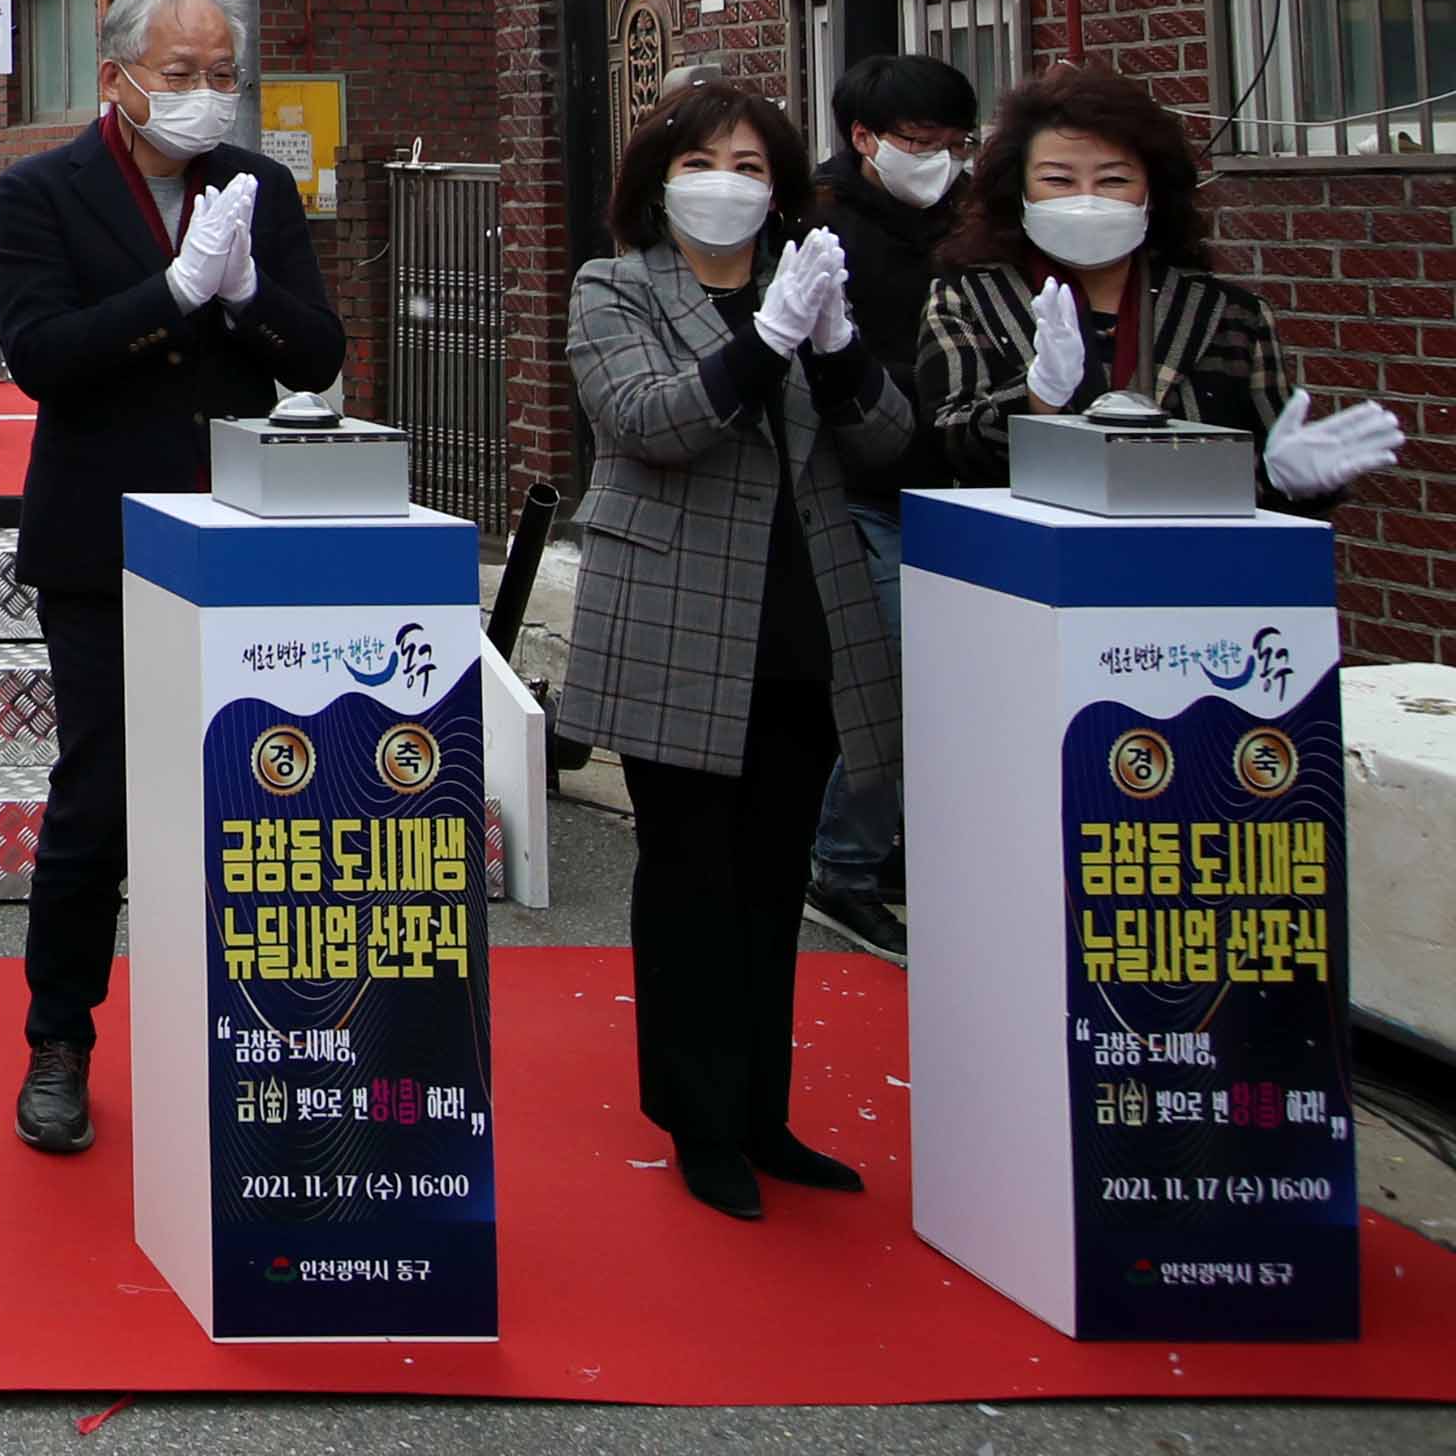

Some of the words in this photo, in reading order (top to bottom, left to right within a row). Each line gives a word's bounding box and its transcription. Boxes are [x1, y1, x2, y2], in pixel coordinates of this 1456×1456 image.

[270, 745, 294, 777] 경
[394, 741, 422, 774] 축
[1128, 748, 1153, 780] 경
[1252, 745, 1280, 778] 축
[221, 818, 323, 892] 금창동
[331, 817, 466, 891] 도시재생
[1080, 821, 1182, 895] 금창동
[1190, 821, 1325, 895] 도시재생
[223, 905, 358, 980] 뉴딜사업
[366, 904, 468, 978] 선포식
[1082, 908, 1217, 983] 뉴딜사업
[1225, 908, 1327, 983] 선포식
[297, 1088, 343, 1121] 빛으로
[241, 1175, 296, 1198] 2021.
[304, 1175, 328, 1198] 11.
[336, 1175, 358, 1198] 17
[366, 1172, 401, 1201] (수)
[409, 1174, 469, 1197] 16:00
[1196, 1178, 1218, 1202] 17
[1226, 1176, 1262, 1205] (수)
[1270, 1178, 1330, 1202] 16:00
[299, 1259, 389, 1282] 인천광역시
[395, 1260, 431, 1282] 동구
[1160, 1262, 1250, 1286] 인천광역시
[1256, 1264, 1292, 1286] 동구
